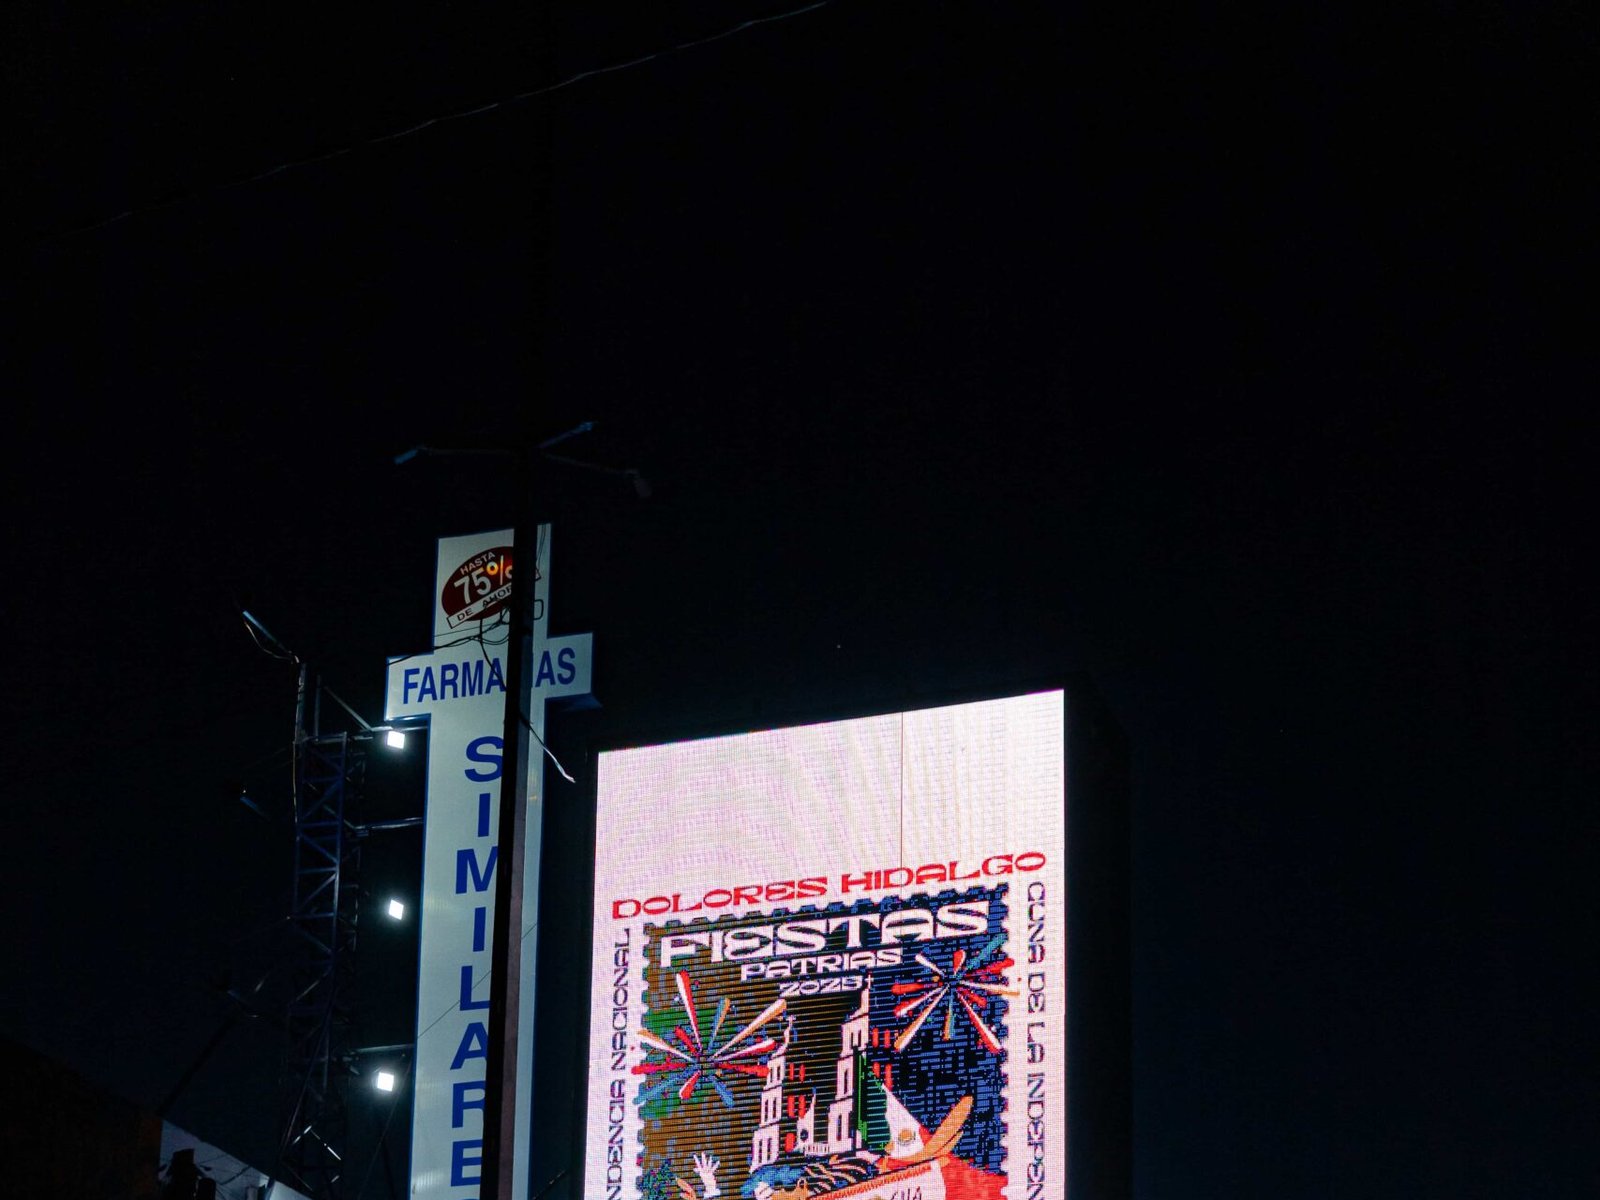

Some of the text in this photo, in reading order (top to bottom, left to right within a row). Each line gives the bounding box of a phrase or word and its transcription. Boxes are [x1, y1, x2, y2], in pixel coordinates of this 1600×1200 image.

[454, 555, 513, 604] 75%
[460, 551, 495, 575] HASTA
[456, 608, 473, 621] DE
[403, 647, 576, 704] FARMAAS
[612, 852, 1046, 919] DOLORES HIDALGO
[661, 900, 989, 968] FIESTAS
[1027, 882, 1045, 963] CUNA
[741, 948, 903, 982] PATRIAS
[779, 975, 864, 998] 2025
[611, 928, 630, 1071] NACIONAL
[1027, 973, 1045, 1013] DE
[1027, 1022, 1045, 1063] LA
